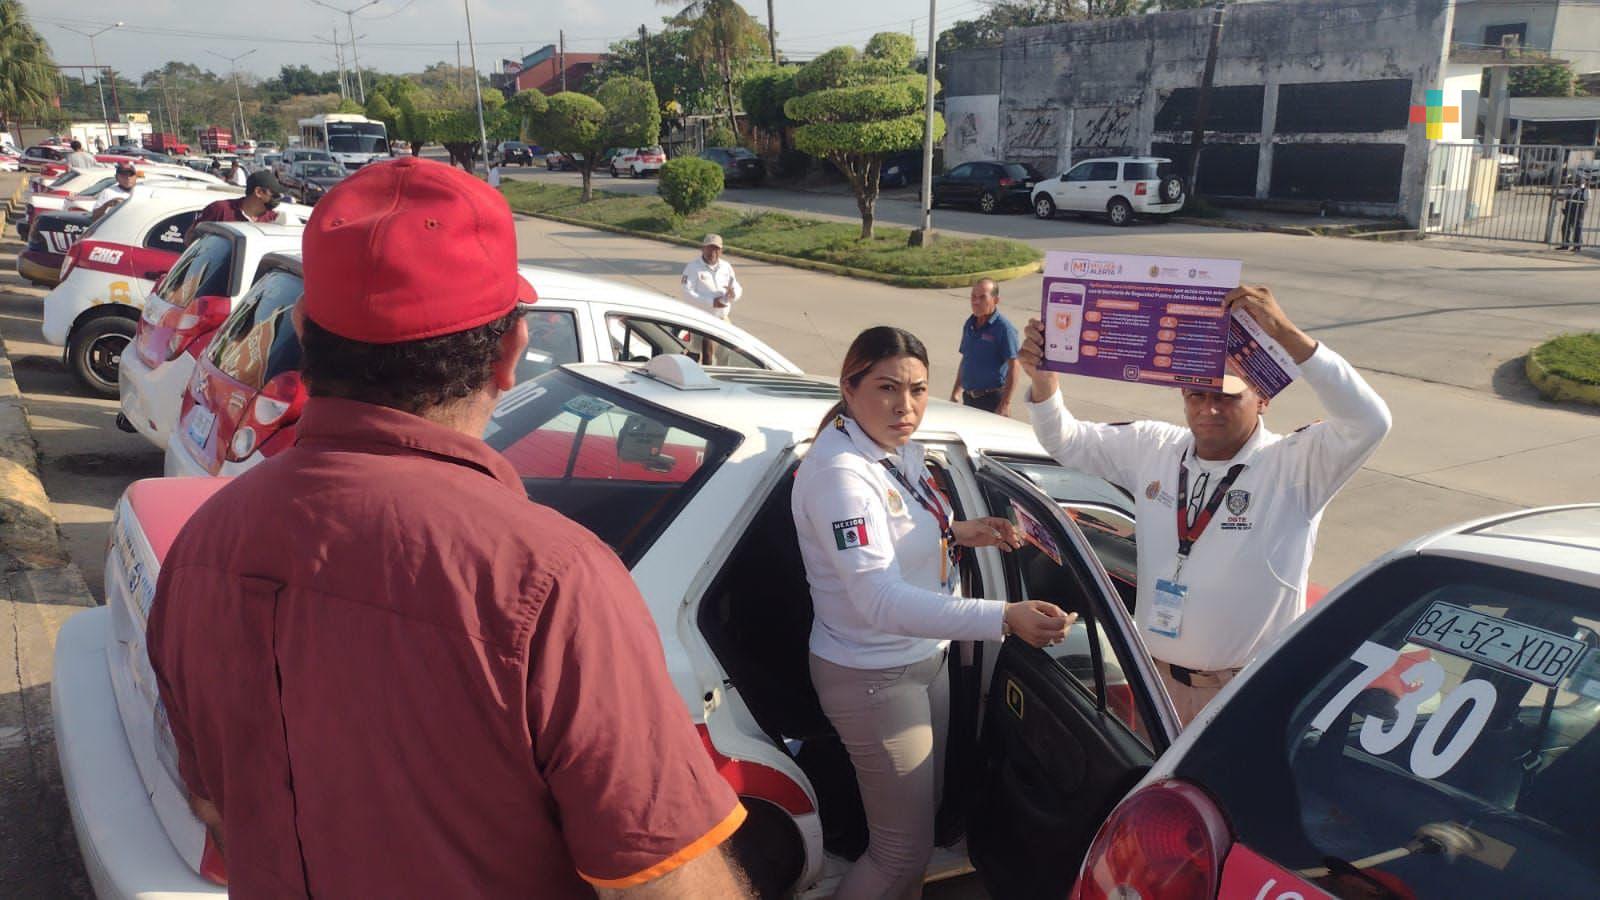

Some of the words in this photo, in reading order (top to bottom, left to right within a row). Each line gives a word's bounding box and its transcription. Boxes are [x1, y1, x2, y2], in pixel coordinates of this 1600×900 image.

[834, 518, 864, 529] MEXICO
[1415, 609, 1573, 677] 84-52-XDB
[1310, 640, 1498, 780] 730
